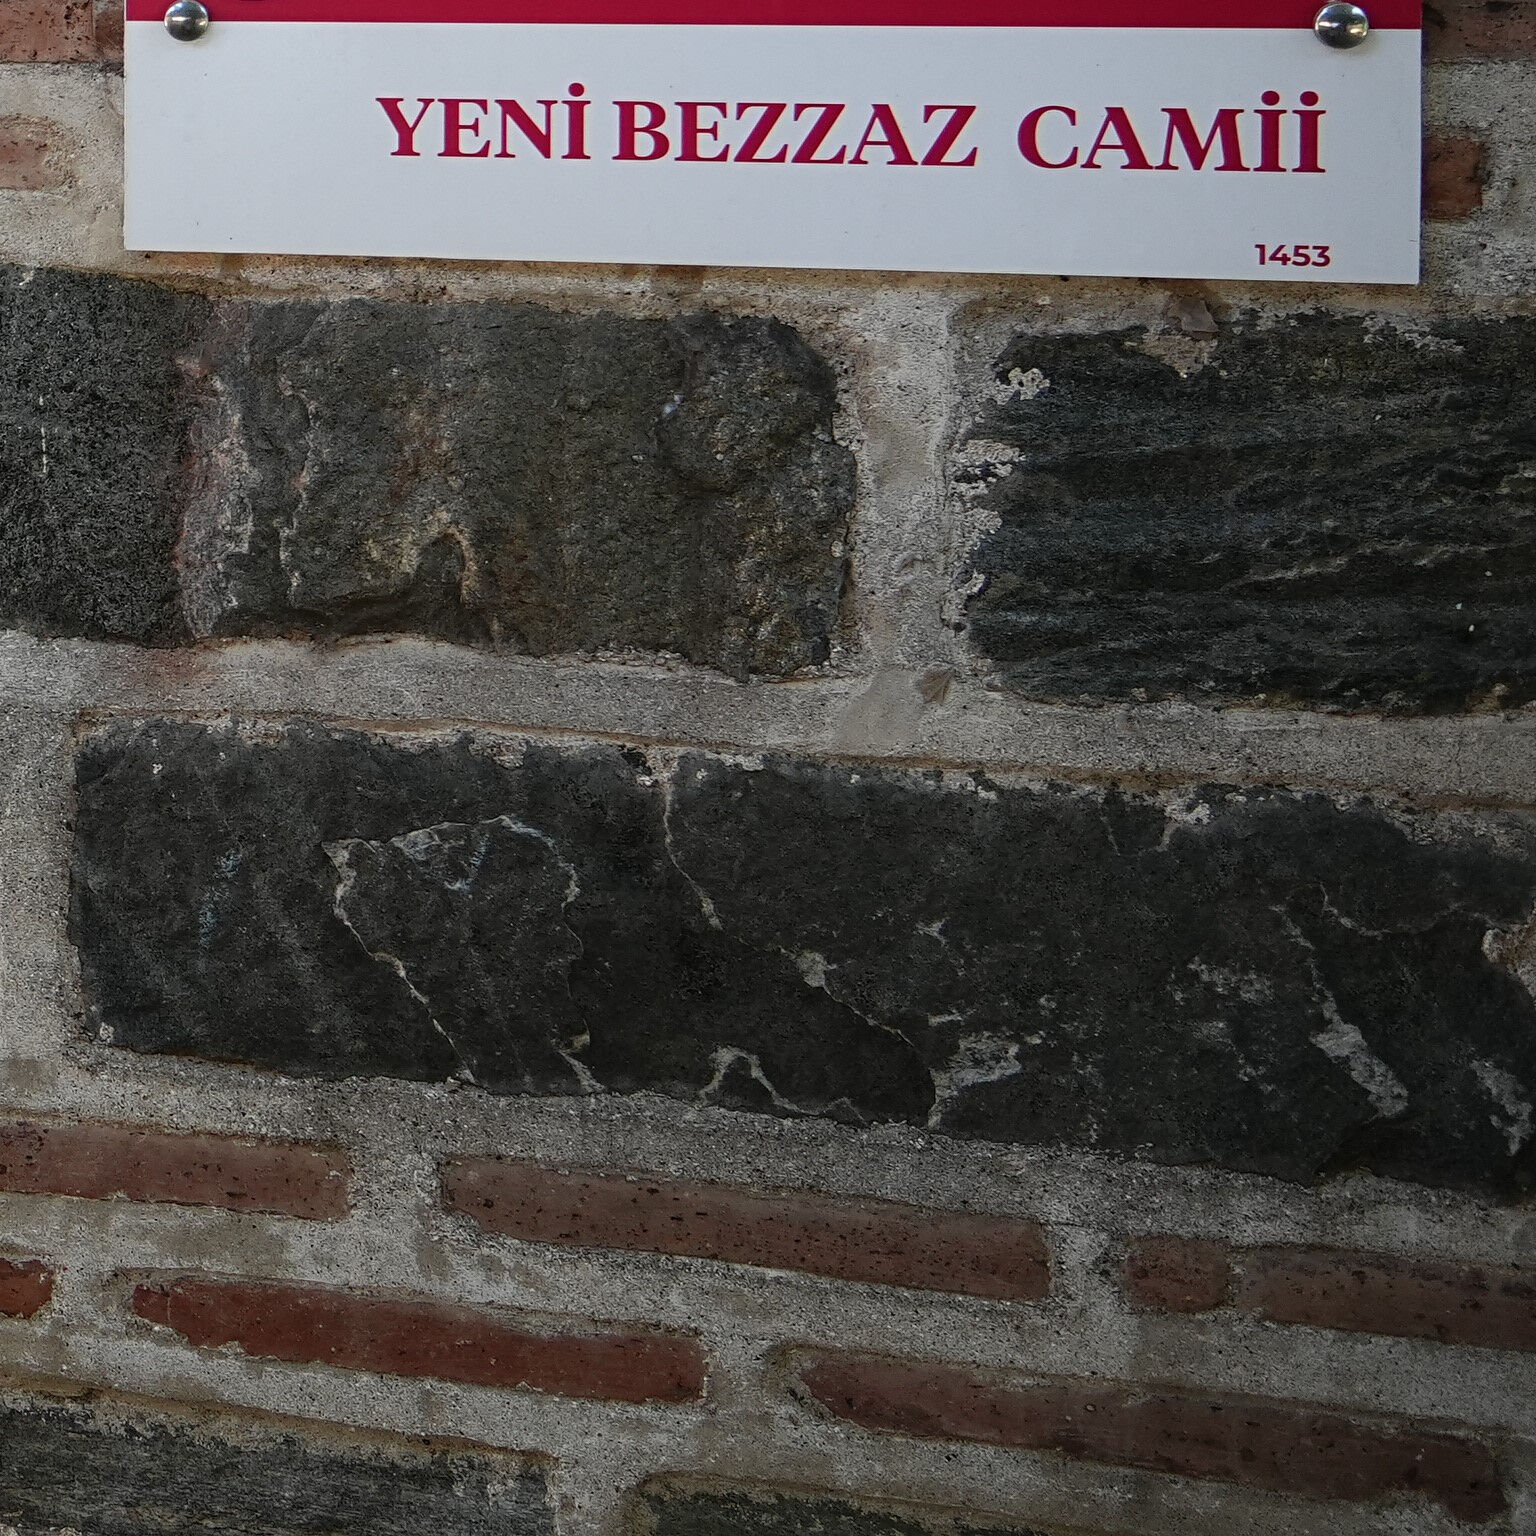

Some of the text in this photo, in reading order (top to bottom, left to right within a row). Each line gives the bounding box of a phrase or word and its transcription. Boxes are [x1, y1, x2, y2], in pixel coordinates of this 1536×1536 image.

[375, 82, 1328, 174] YENİ BEZZAZ CAMİİ
[1253, 243, 1332, 268] 1453
